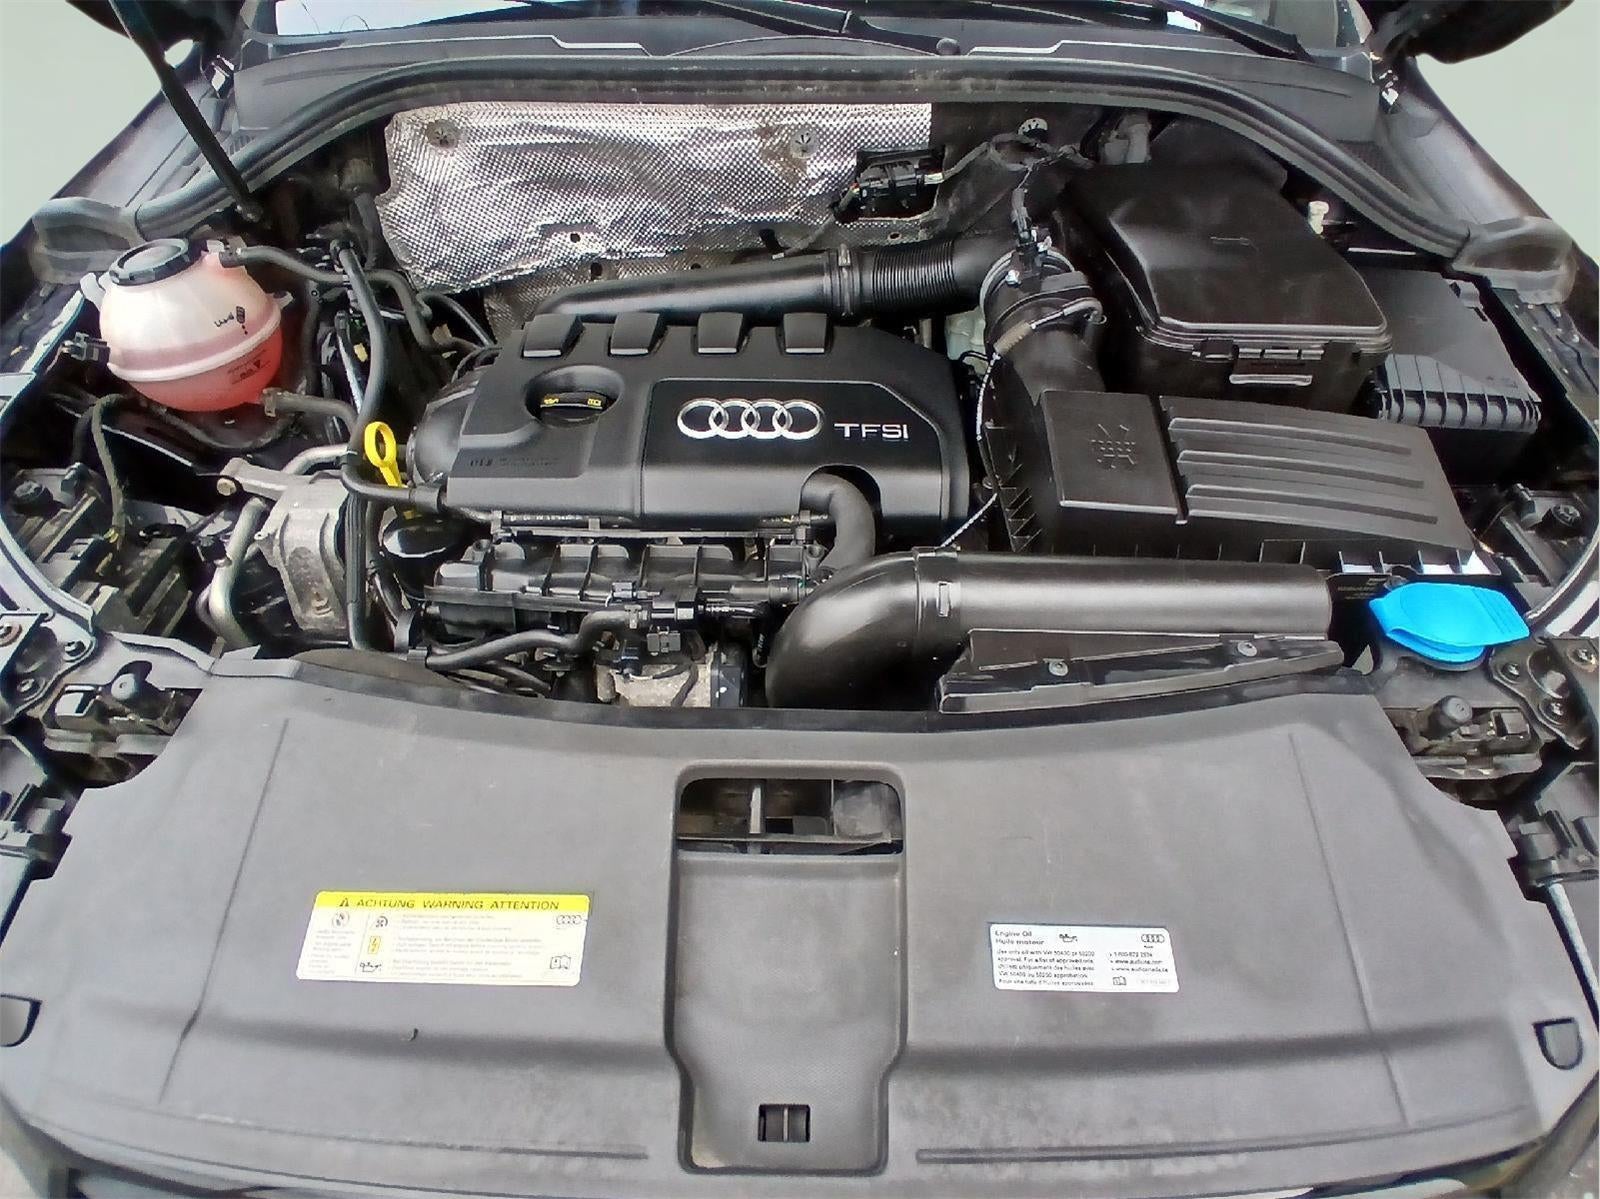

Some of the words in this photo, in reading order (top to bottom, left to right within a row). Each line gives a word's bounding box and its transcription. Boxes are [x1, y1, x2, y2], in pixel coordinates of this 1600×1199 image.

[834, 423, 909, 439] TFSI
[357, 899, 415, 908] ACHTUNG
[423, 900, 483, 909] WARNING
[490, 901, 560, 910] ATTENTION
[995, 930, 1020, 938] Engine
